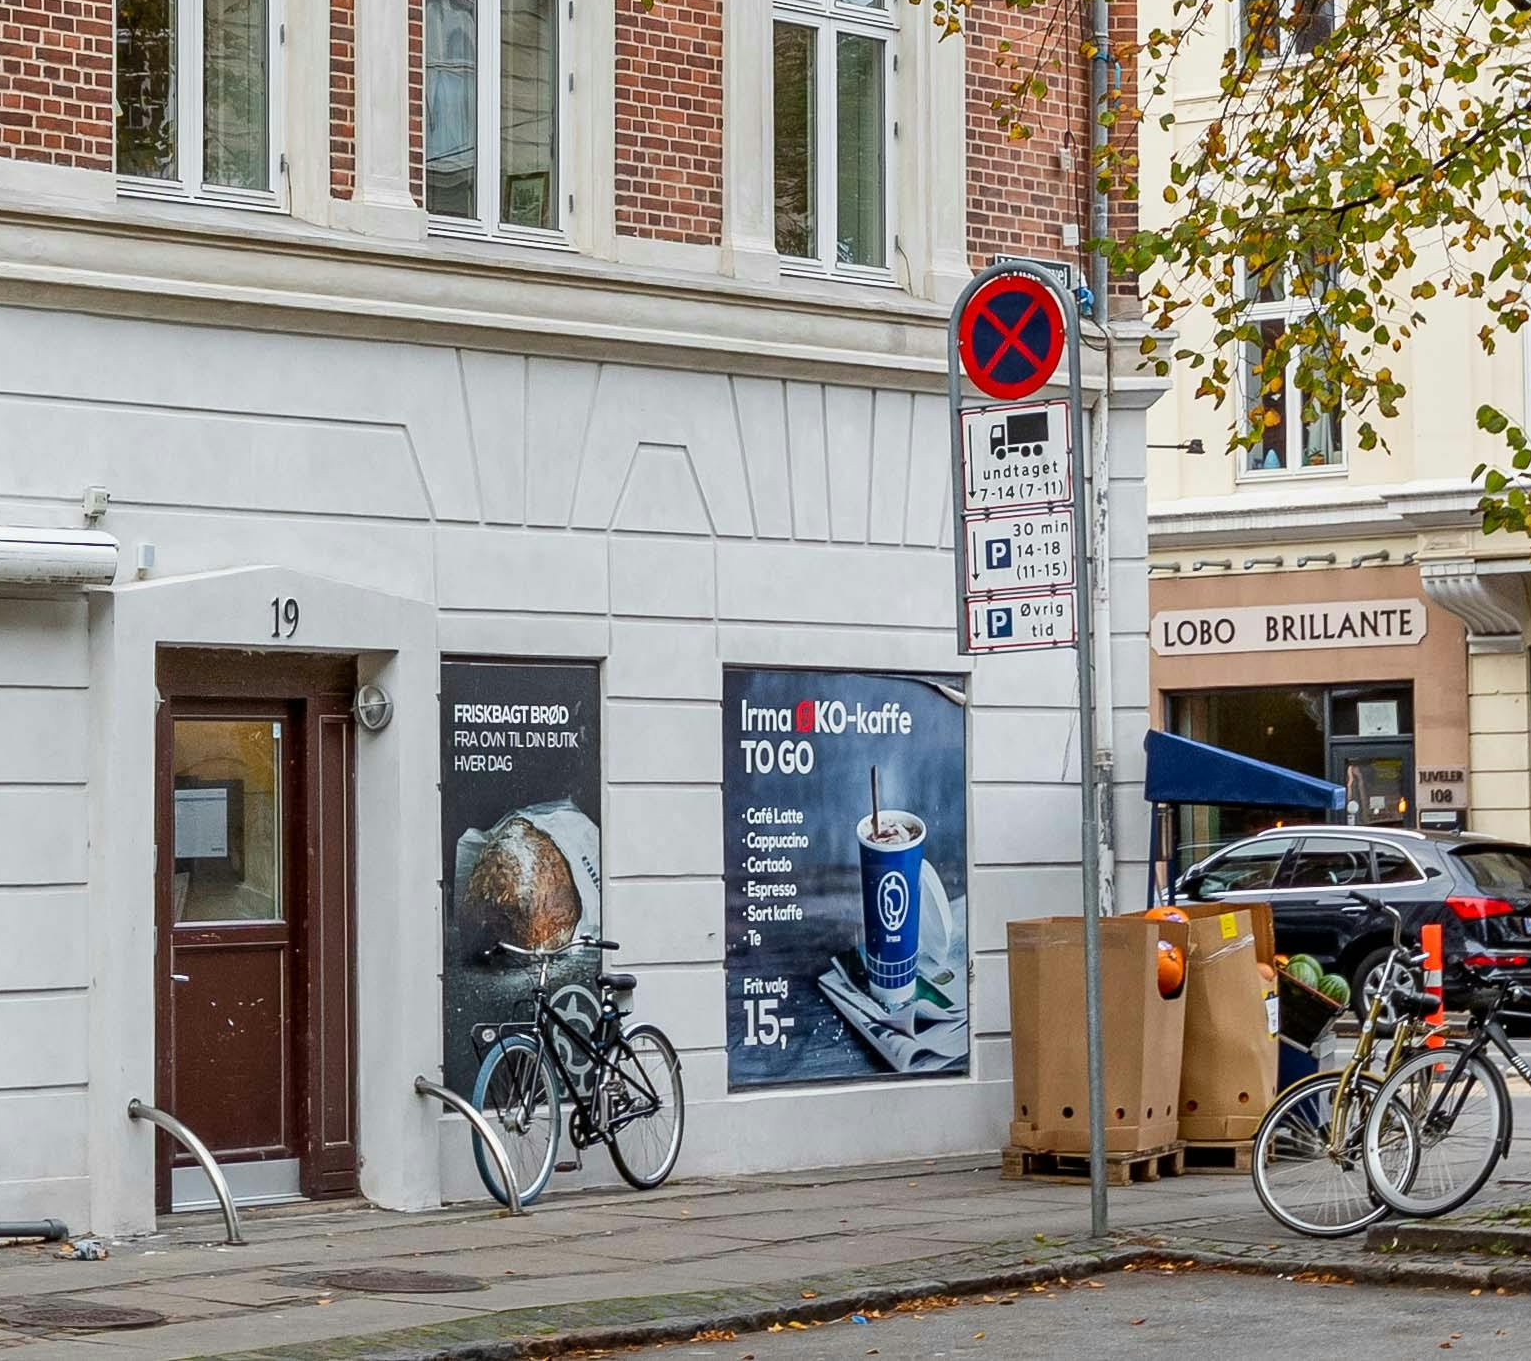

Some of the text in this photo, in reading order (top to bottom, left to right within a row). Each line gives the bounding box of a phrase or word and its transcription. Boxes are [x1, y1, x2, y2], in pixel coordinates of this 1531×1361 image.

[983, 460, 1058, 481] undtaget
[1012, 520, 1069, 537] 30 min
[1017, 541, 1061, 558] 14-18
[1016, 560, 1068, 580] (11-15)
[270, 596, 300, 639] 19
[1020, 602, 1064, 617] Øvrig
[1032, 623, 1054, 638] tid
[1163, 608, 1414, 647] LOBO BRILLANTE
[453, 704, 570, 725] FRISKBAGT BRØD
[741, 699, 792, 732] Irma
[453, 730, 579, 748] FRA OVN TIL DIN BUTIK
[453, 755, 513, 772] HVER DAG
[740, 739, 814, 774] TO GO
[1418, 770, 1465, 784] JUVELER
[1430, 788, 1453, 803] 108
[746, 807, 804, 825] Café Latte
[746, 832, 809, 852] Cappuccino
[747, 856, 793, 873] Cortado
[747, 880, 797, 901] Espresso
[747, 904, 803, 922] Sort kaffe
[747, 929, 762, 947] Te
[743, 976, 789, 999] Frit valg
